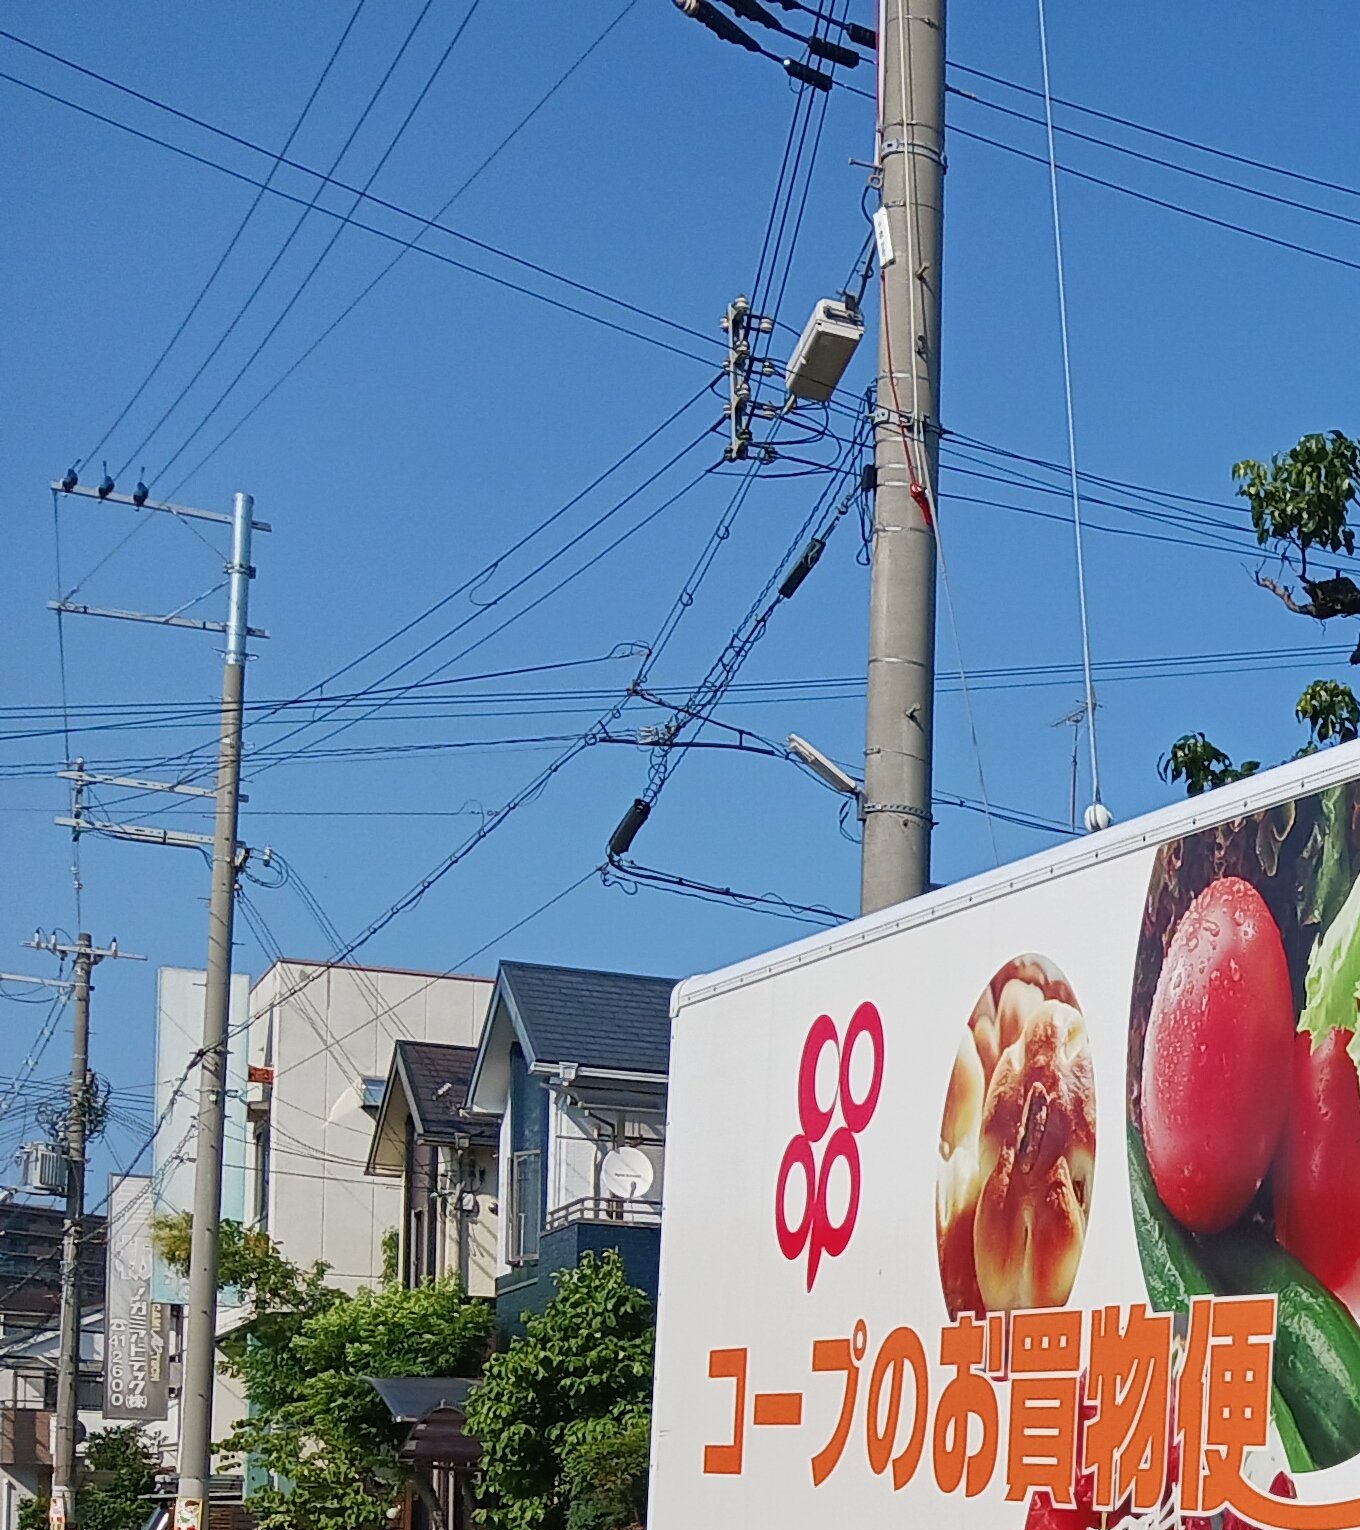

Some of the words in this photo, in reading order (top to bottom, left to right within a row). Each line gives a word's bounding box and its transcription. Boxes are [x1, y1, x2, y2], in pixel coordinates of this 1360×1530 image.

[703, 1298, 1277, 1510] コープのお買物便
